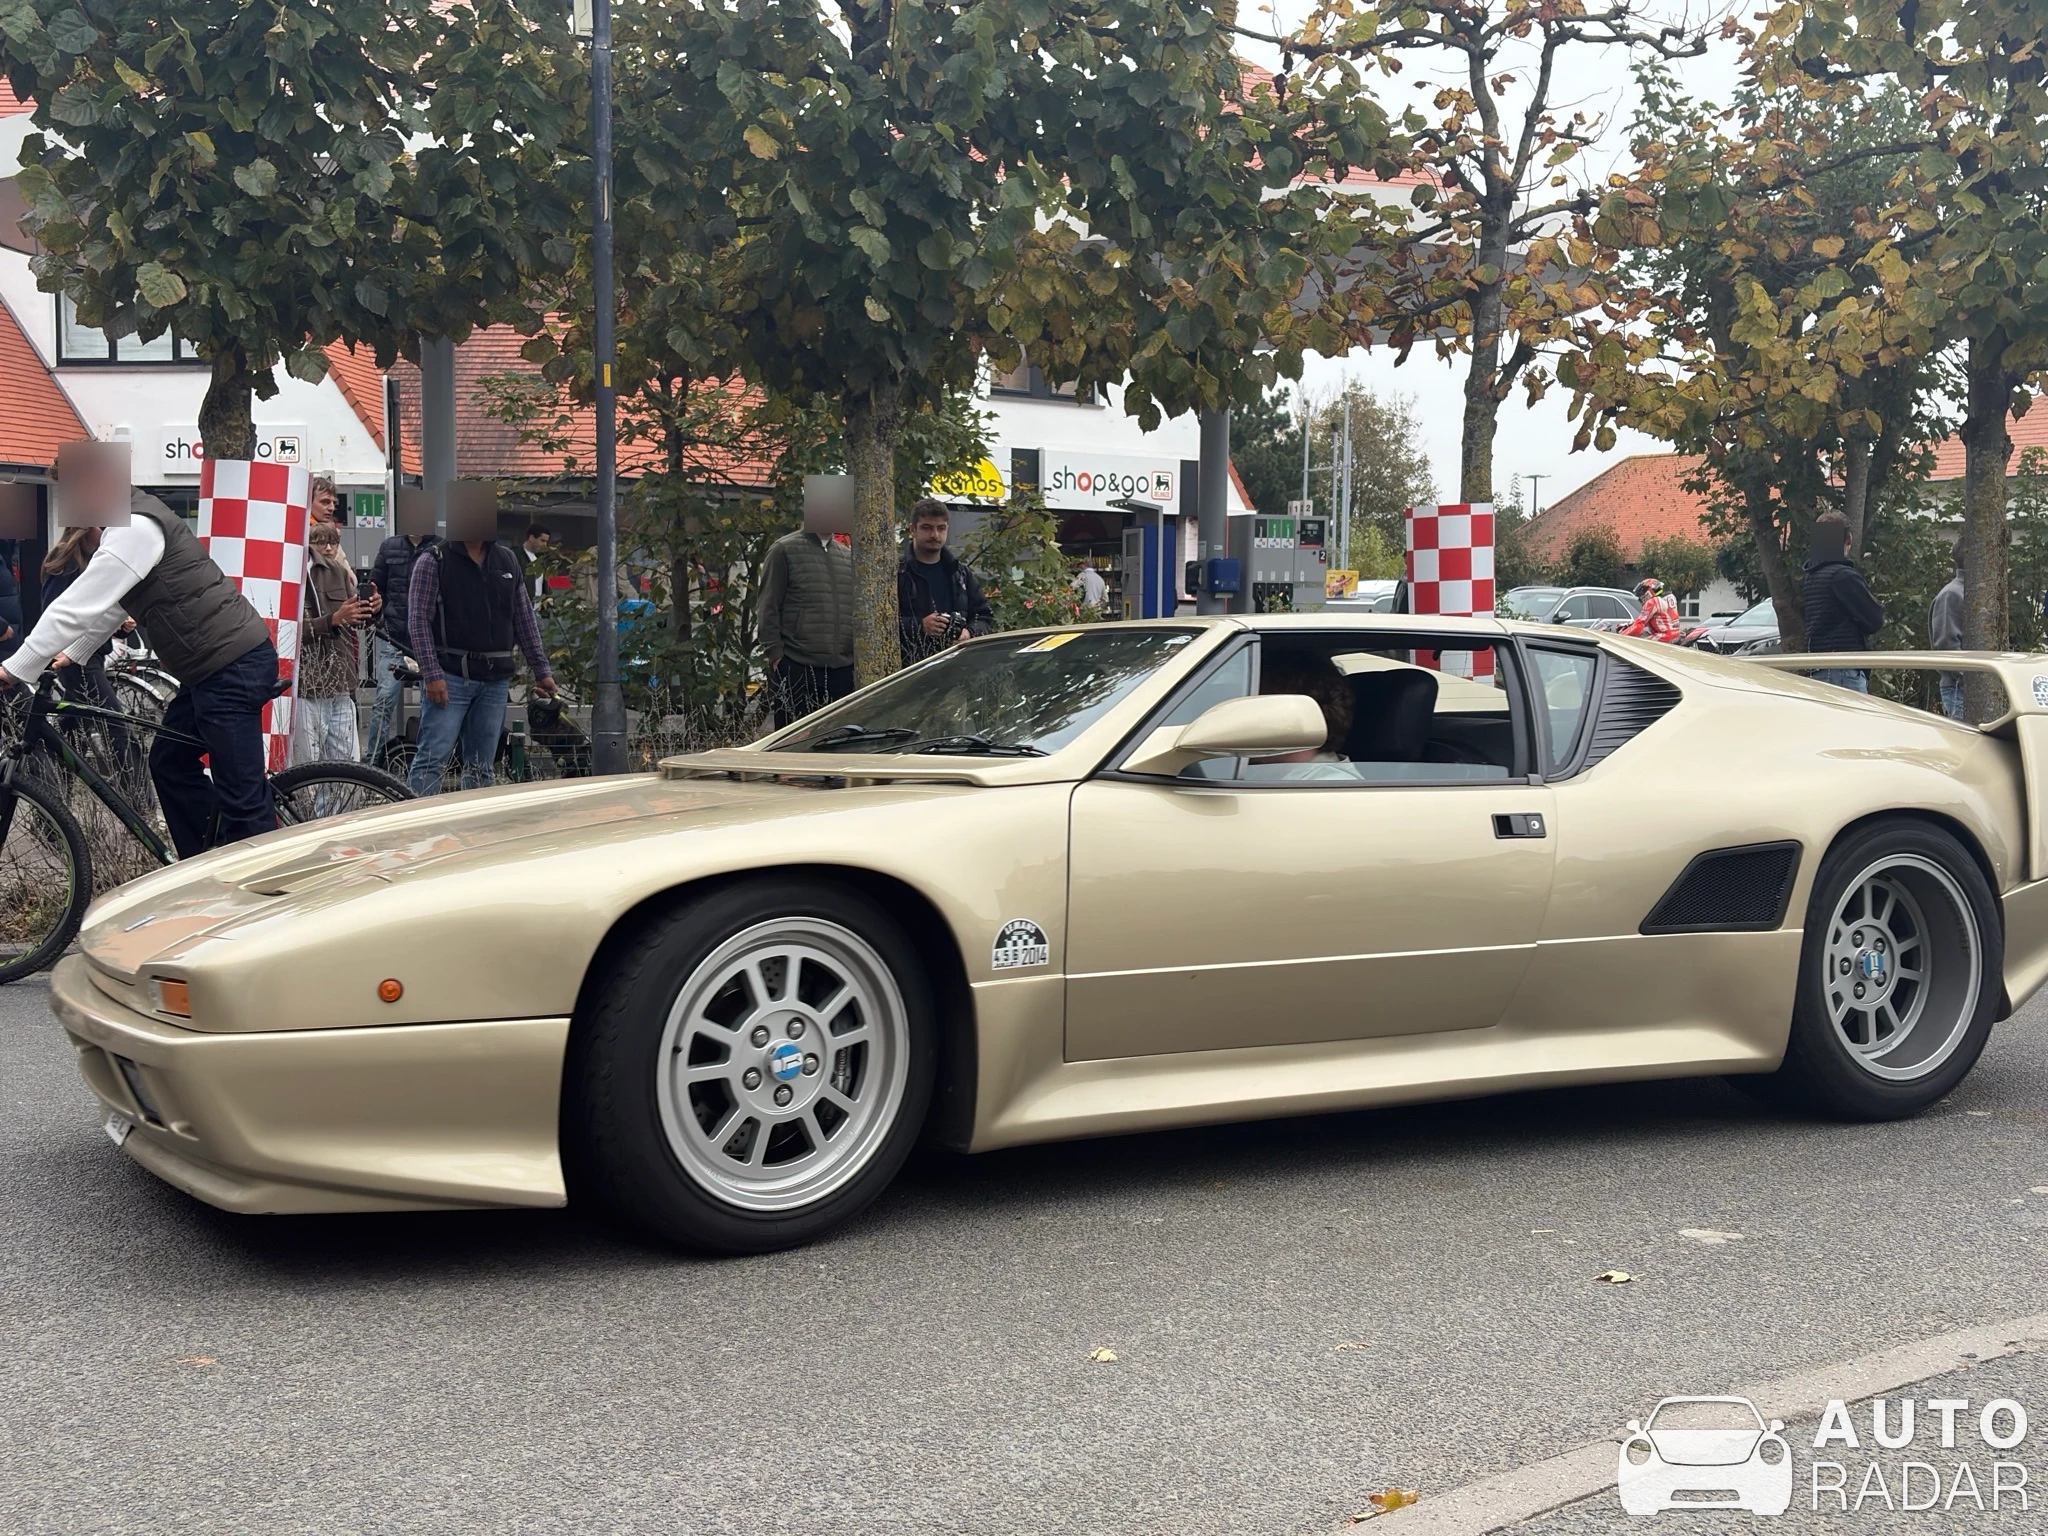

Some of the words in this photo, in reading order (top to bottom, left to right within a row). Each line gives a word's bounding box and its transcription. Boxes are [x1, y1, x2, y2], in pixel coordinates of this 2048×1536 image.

[165, 437, 272, 459] shoo
[1053, 465, 1149, 498] shop&go
[1305, 504, 1311, 512] 2
[1320, 551, 1326, 560] 2
[1022, 946, 1047, 965] 2014
